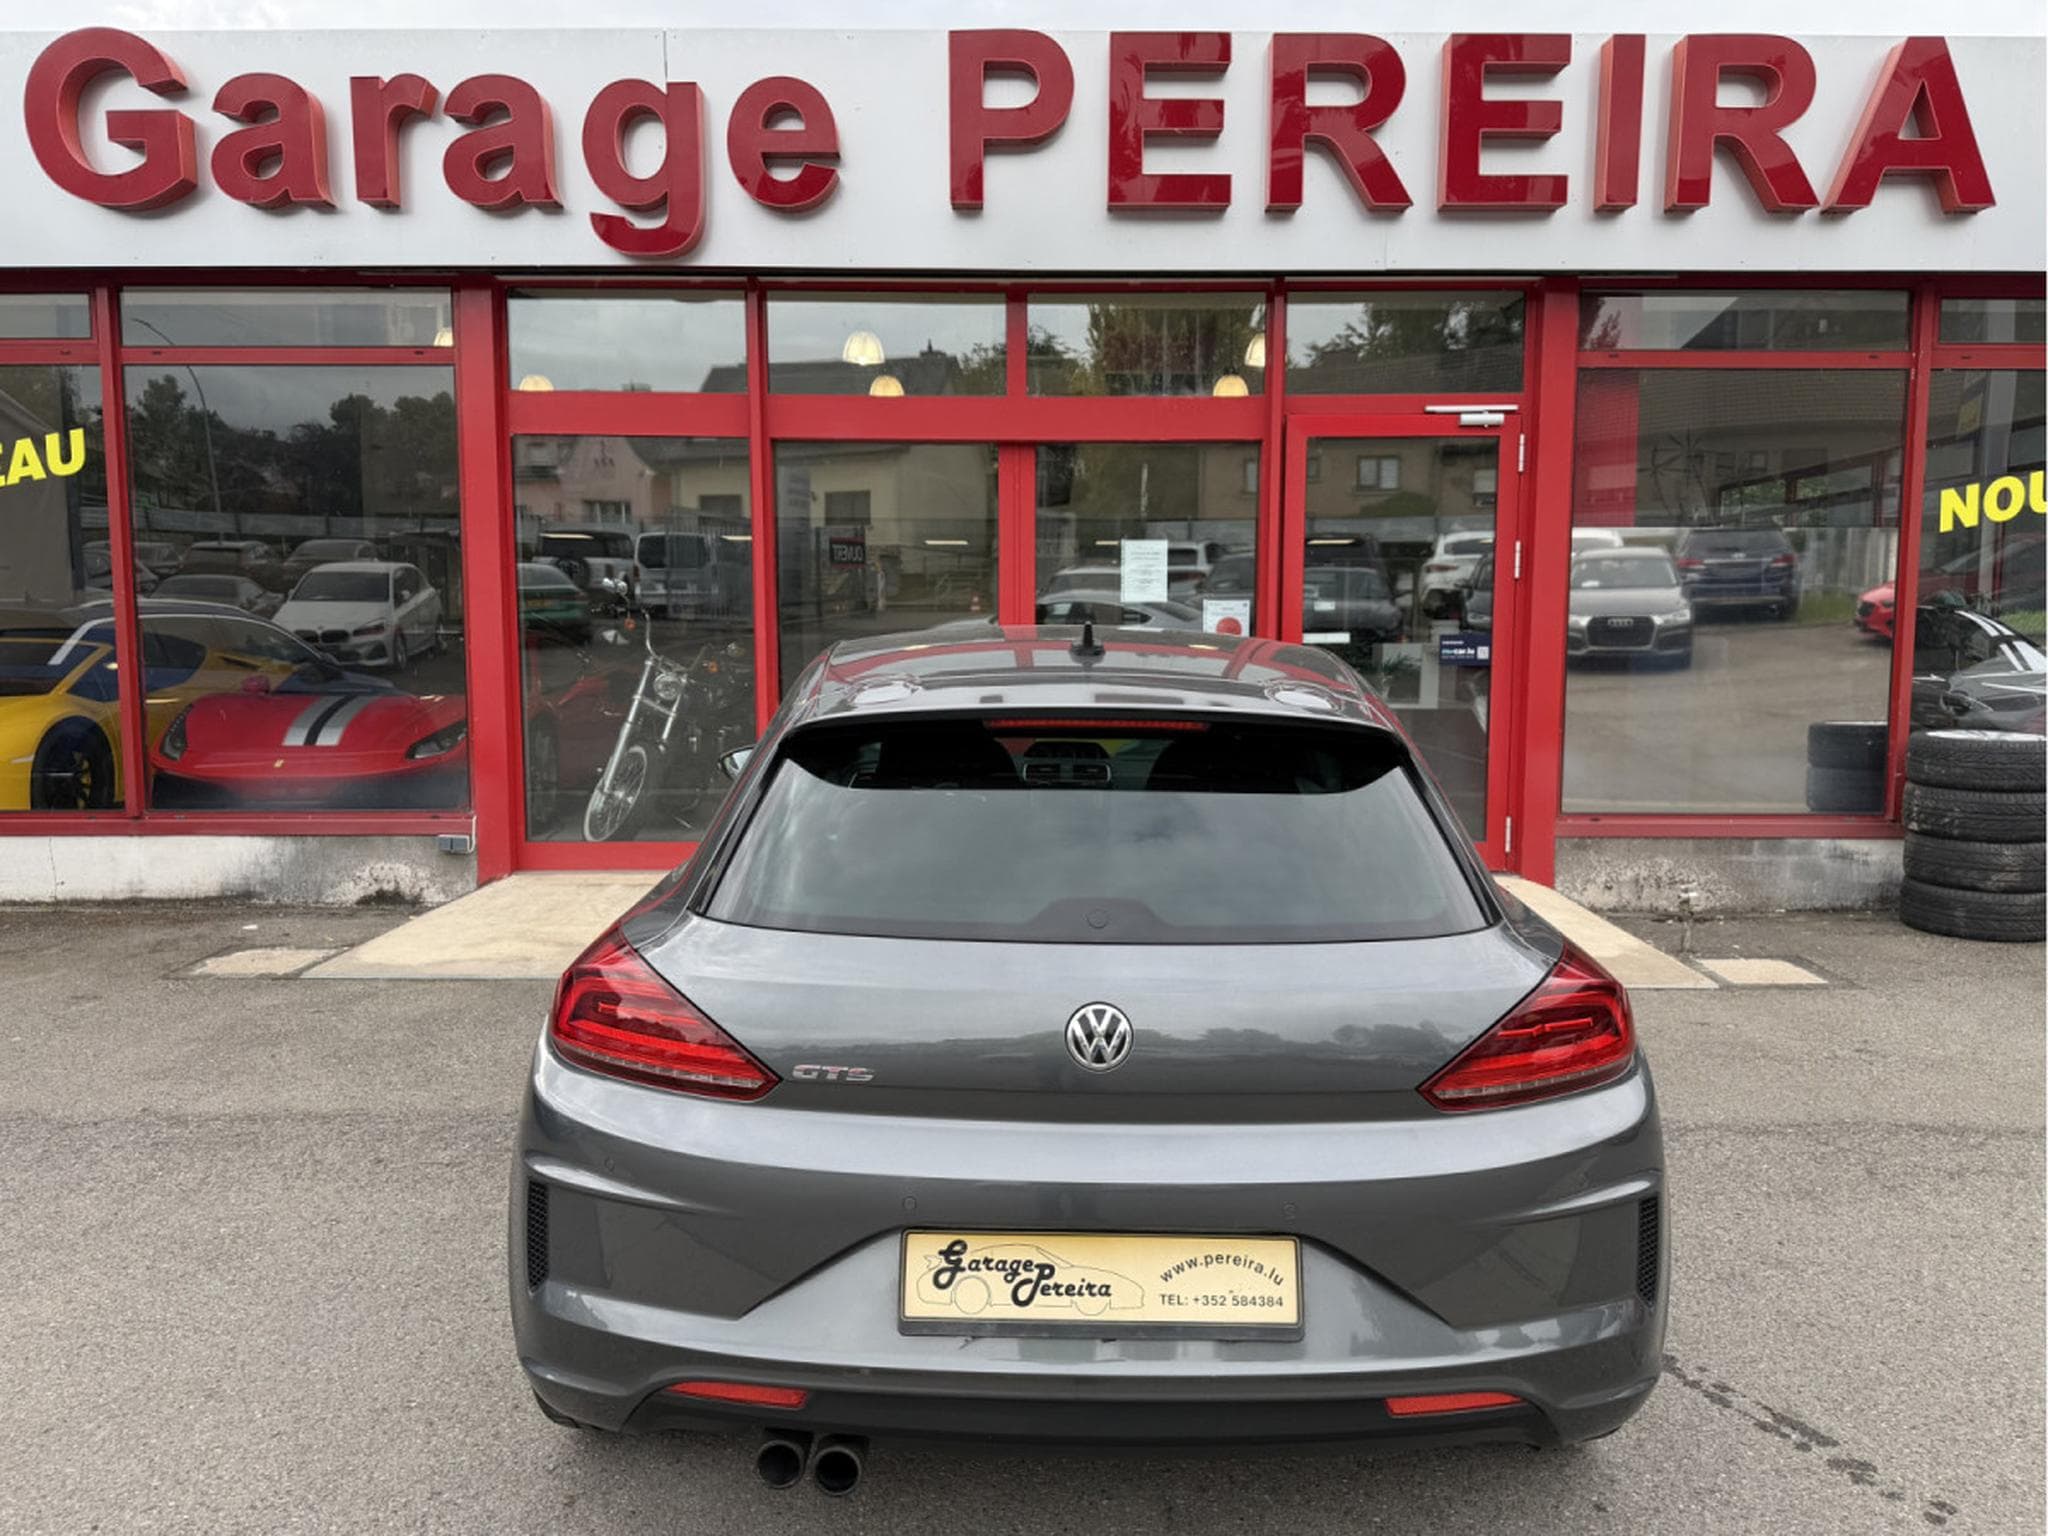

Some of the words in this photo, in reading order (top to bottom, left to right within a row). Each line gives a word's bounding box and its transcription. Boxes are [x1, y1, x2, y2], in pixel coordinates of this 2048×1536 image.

[24, 27, 841, 258] Garage
[948, 29, 1997, 213] PEREIRA
[0, 427, 86, 487] AU
[792, 1063, 876, 1083] GTS
[933, 1239, 1034, 1290] Garage
[1011, 1263, 1112, 1307] Pereira
[1160, 1253, 1284, 1286] www.pereira.lu
[1160, 1294, 1188, 1306] TEL:
[1193, 1294, 1227, 1307] +352
[1231, 1295, 1283, 1307] 584384
